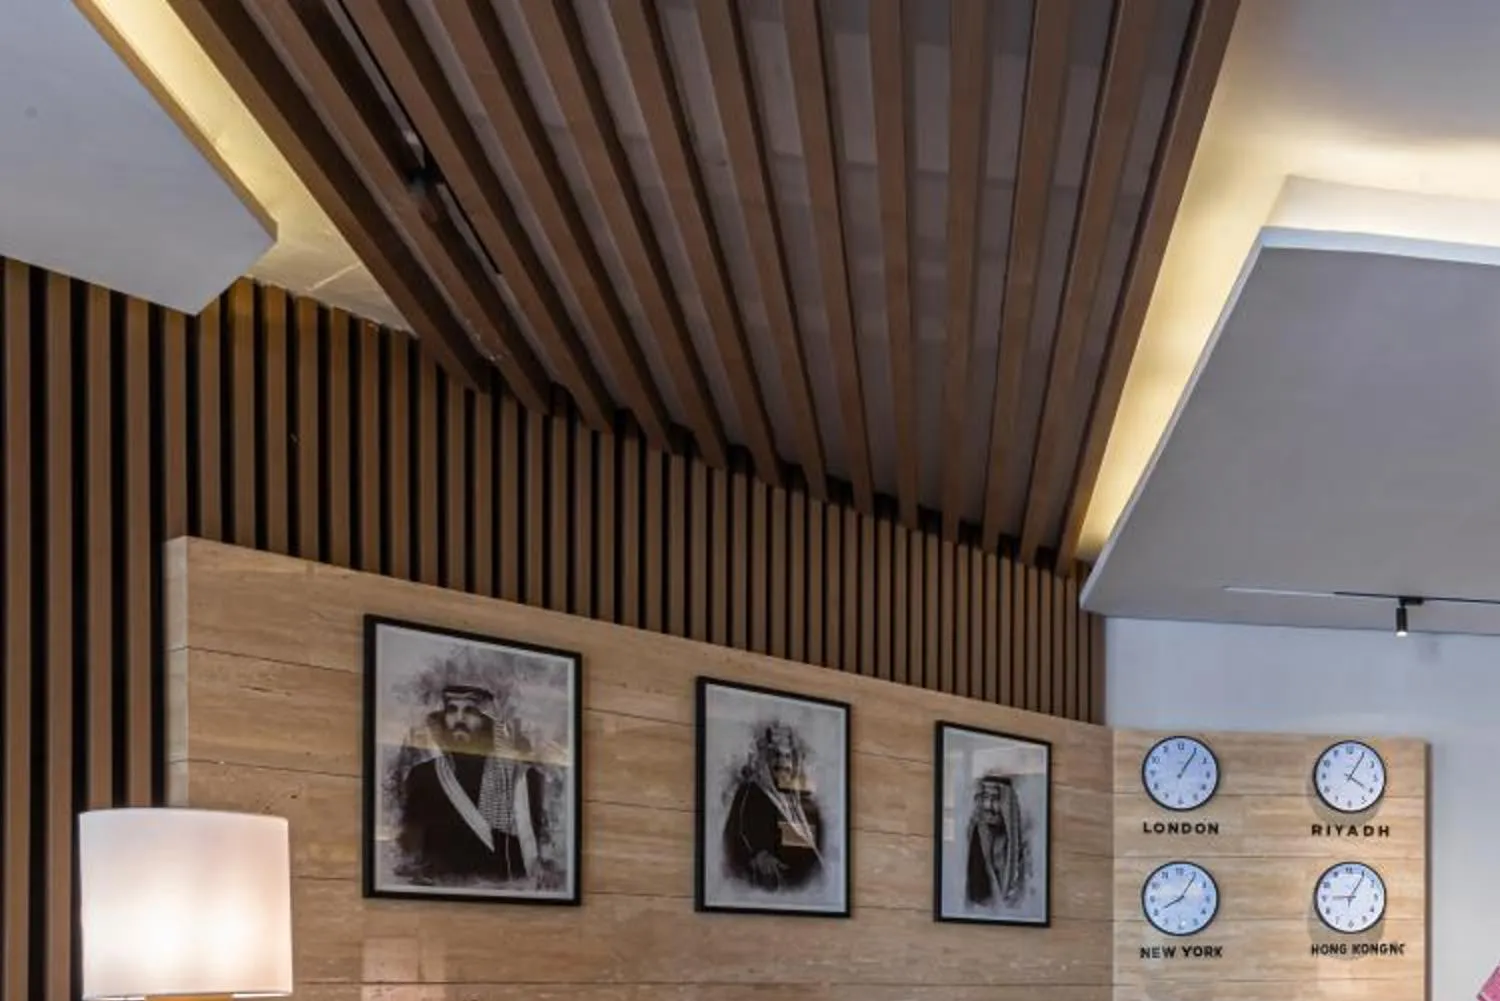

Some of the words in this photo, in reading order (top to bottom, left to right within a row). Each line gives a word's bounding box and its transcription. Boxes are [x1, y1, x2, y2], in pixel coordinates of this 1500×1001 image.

[1143, 822, 1219, 834] LONDON
[1311, 824, 1389, 837] RIYADH
[1140, 946, 1176, 958] NEW
[1182, 946, 1223, 957] YORK
[1311, 944, 1347, 956] HONG
